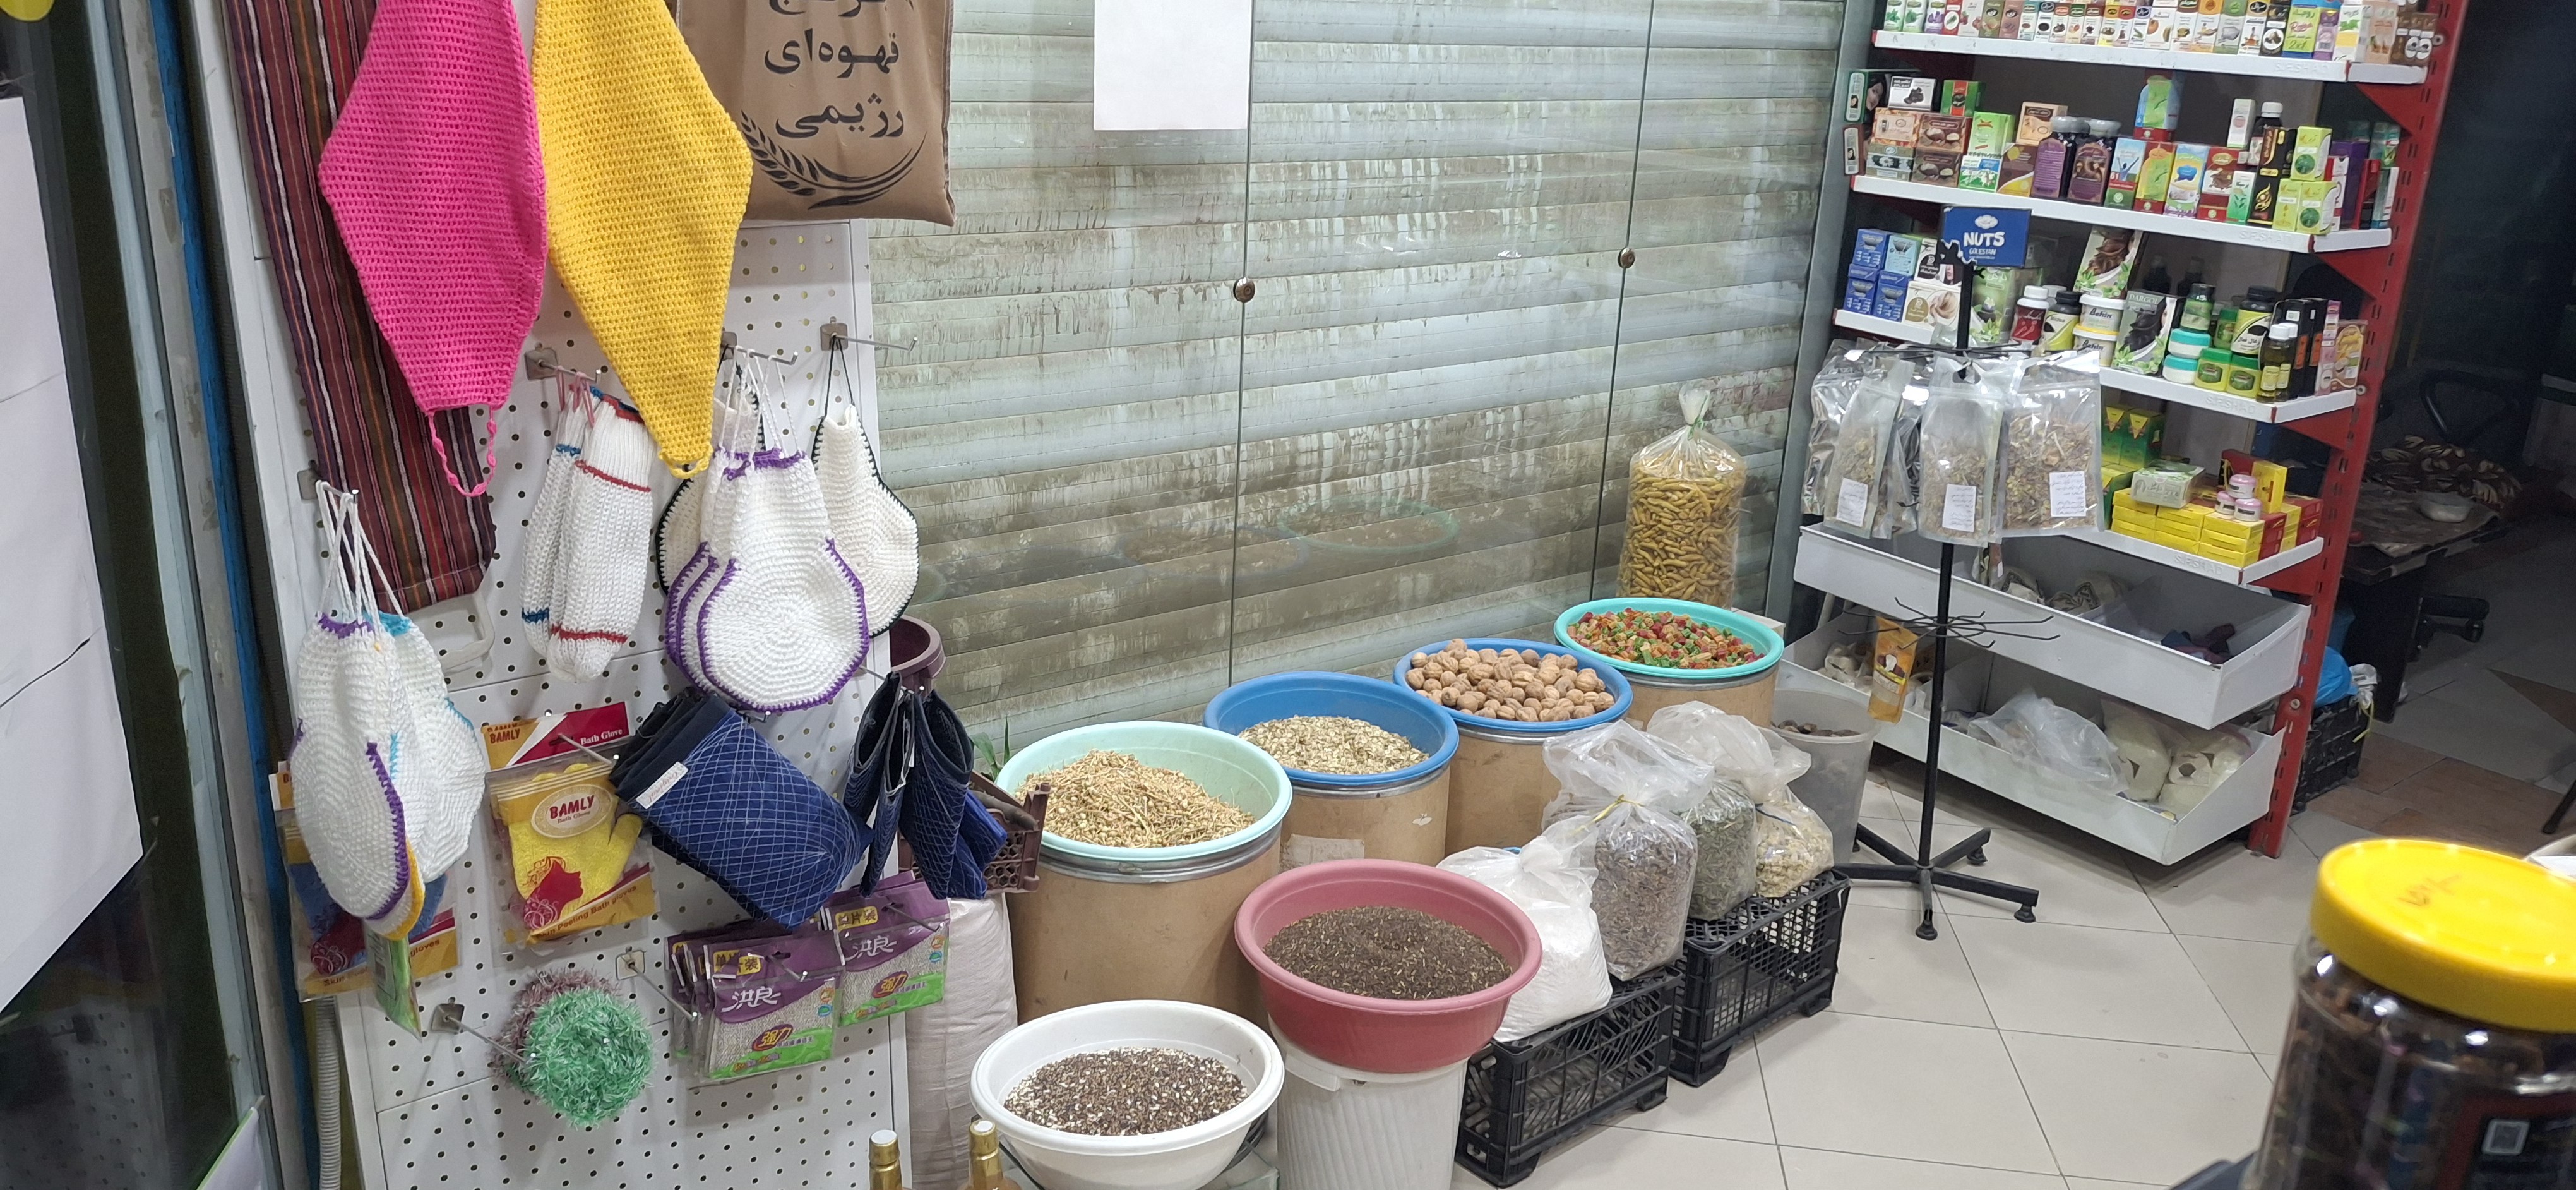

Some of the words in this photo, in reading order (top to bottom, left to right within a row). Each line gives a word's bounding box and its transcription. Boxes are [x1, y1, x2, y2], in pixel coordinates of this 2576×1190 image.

[775, 93, 904, 138] رژیمی
[1964, 231, 2005, 247] NUTS
[2128, 294, 2159, 304] DARGOL
[489, 728, 521, 744] BAMLY
[580, 735, 600, 745] Bath
[600, 728, 623, 740] Glove
[549, 795, 595, 819] BAMLY
[558, 911, 588, 931] Peeling
[590, 902, 610, 914] Bath
[611, 886, 637, 905] gloves
[410, 939, 441, 958] gloves
